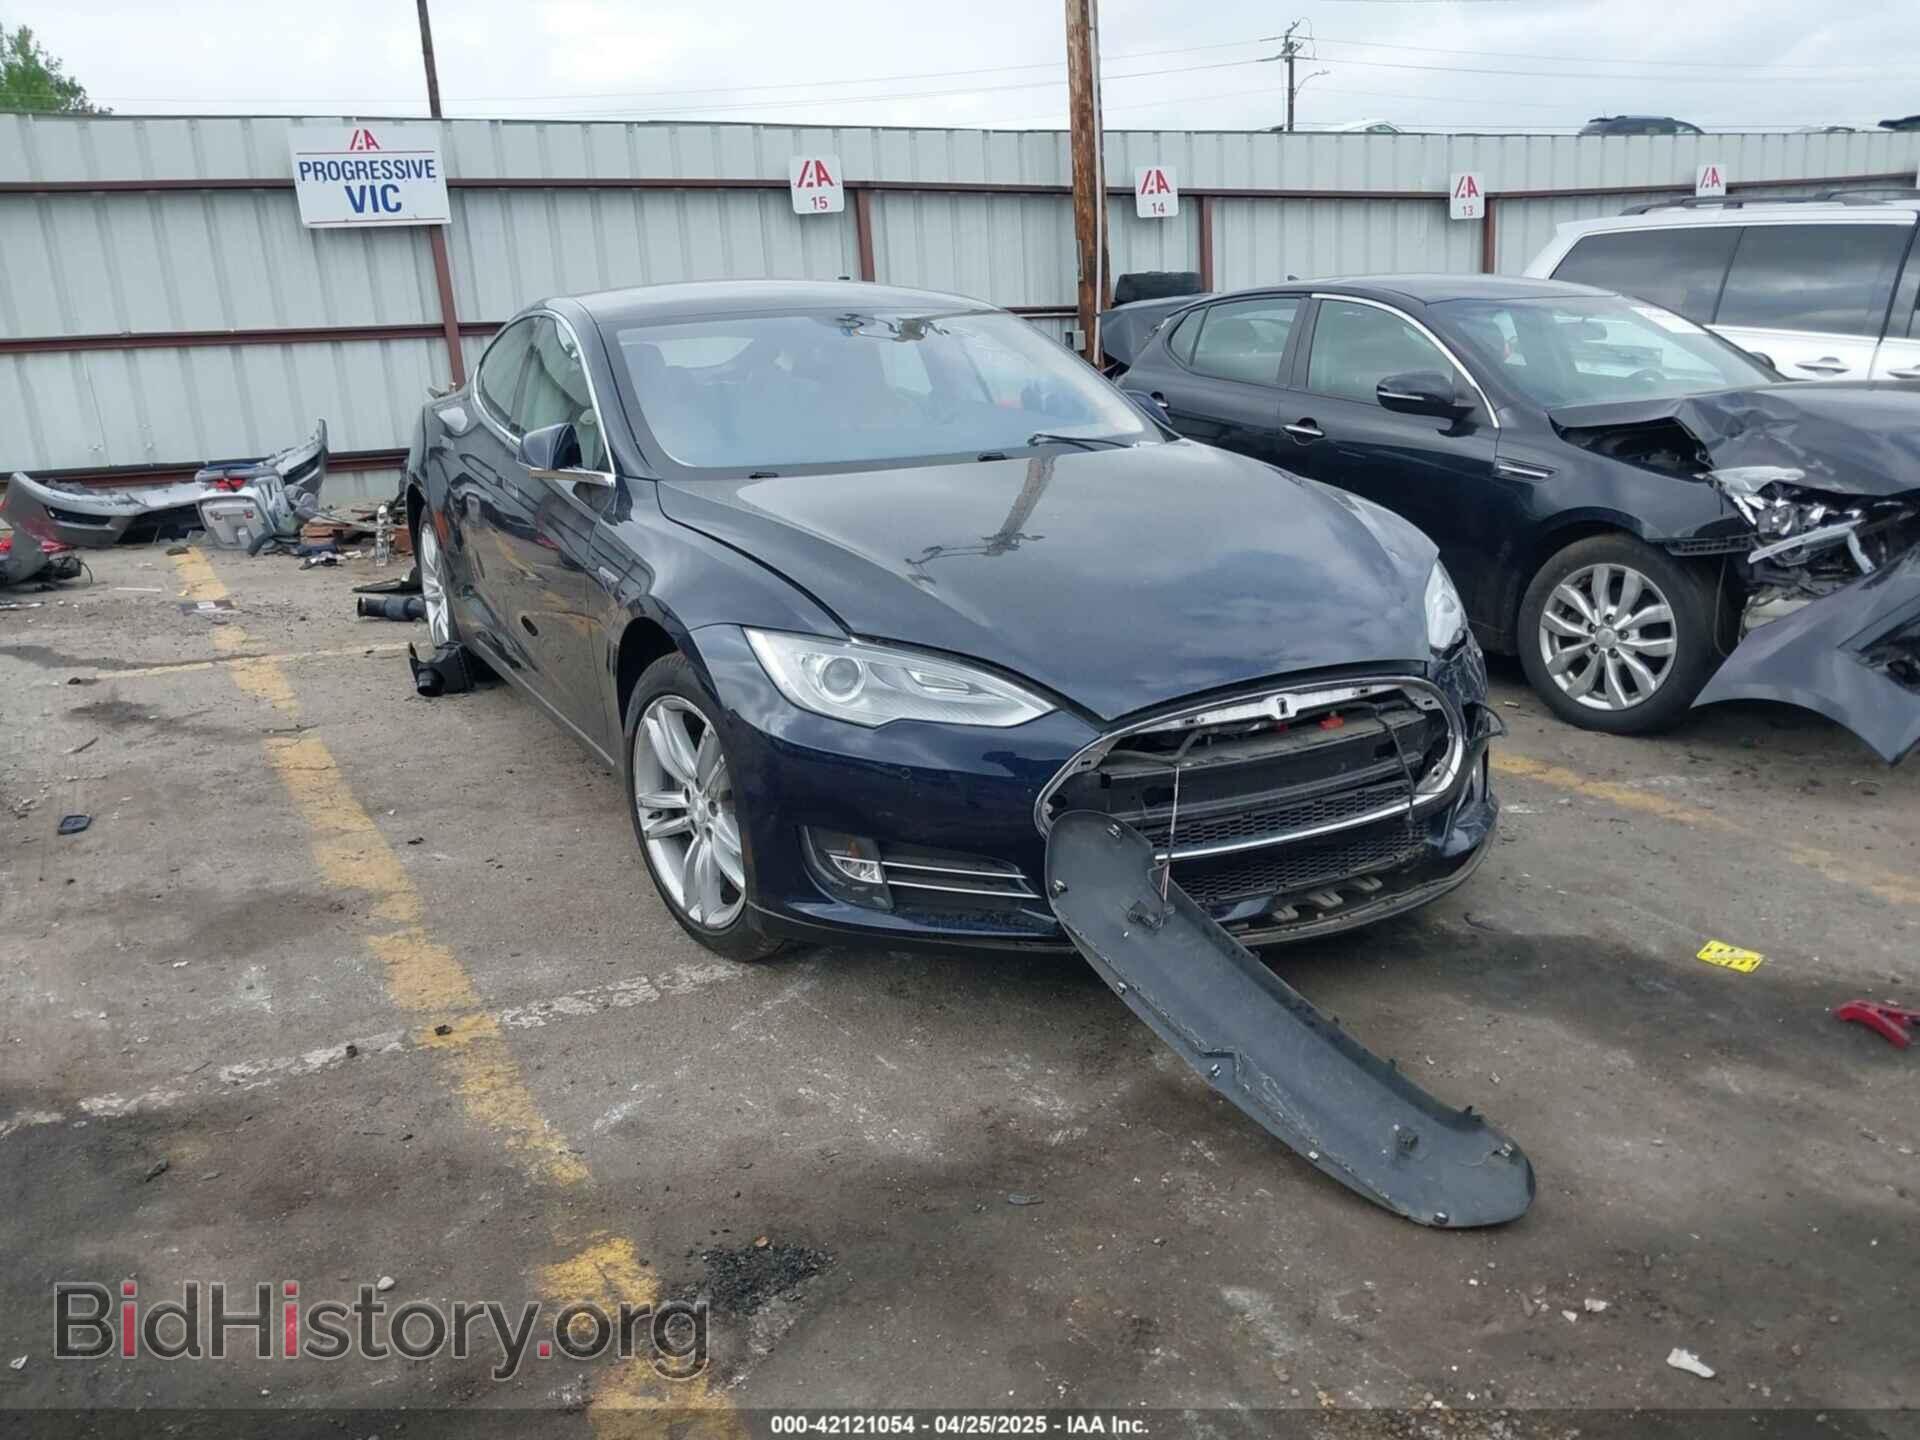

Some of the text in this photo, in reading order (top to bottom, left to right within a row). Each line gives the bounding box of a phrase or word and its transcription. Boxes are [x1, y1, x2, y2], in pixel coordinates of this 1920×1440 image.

[299, 159, 437, 181] PROGRESSIVE
[345, 183, 402, 214] VIC
[811, 196, 828, 209] 15
[1152, 202, 1165, 215] 14
